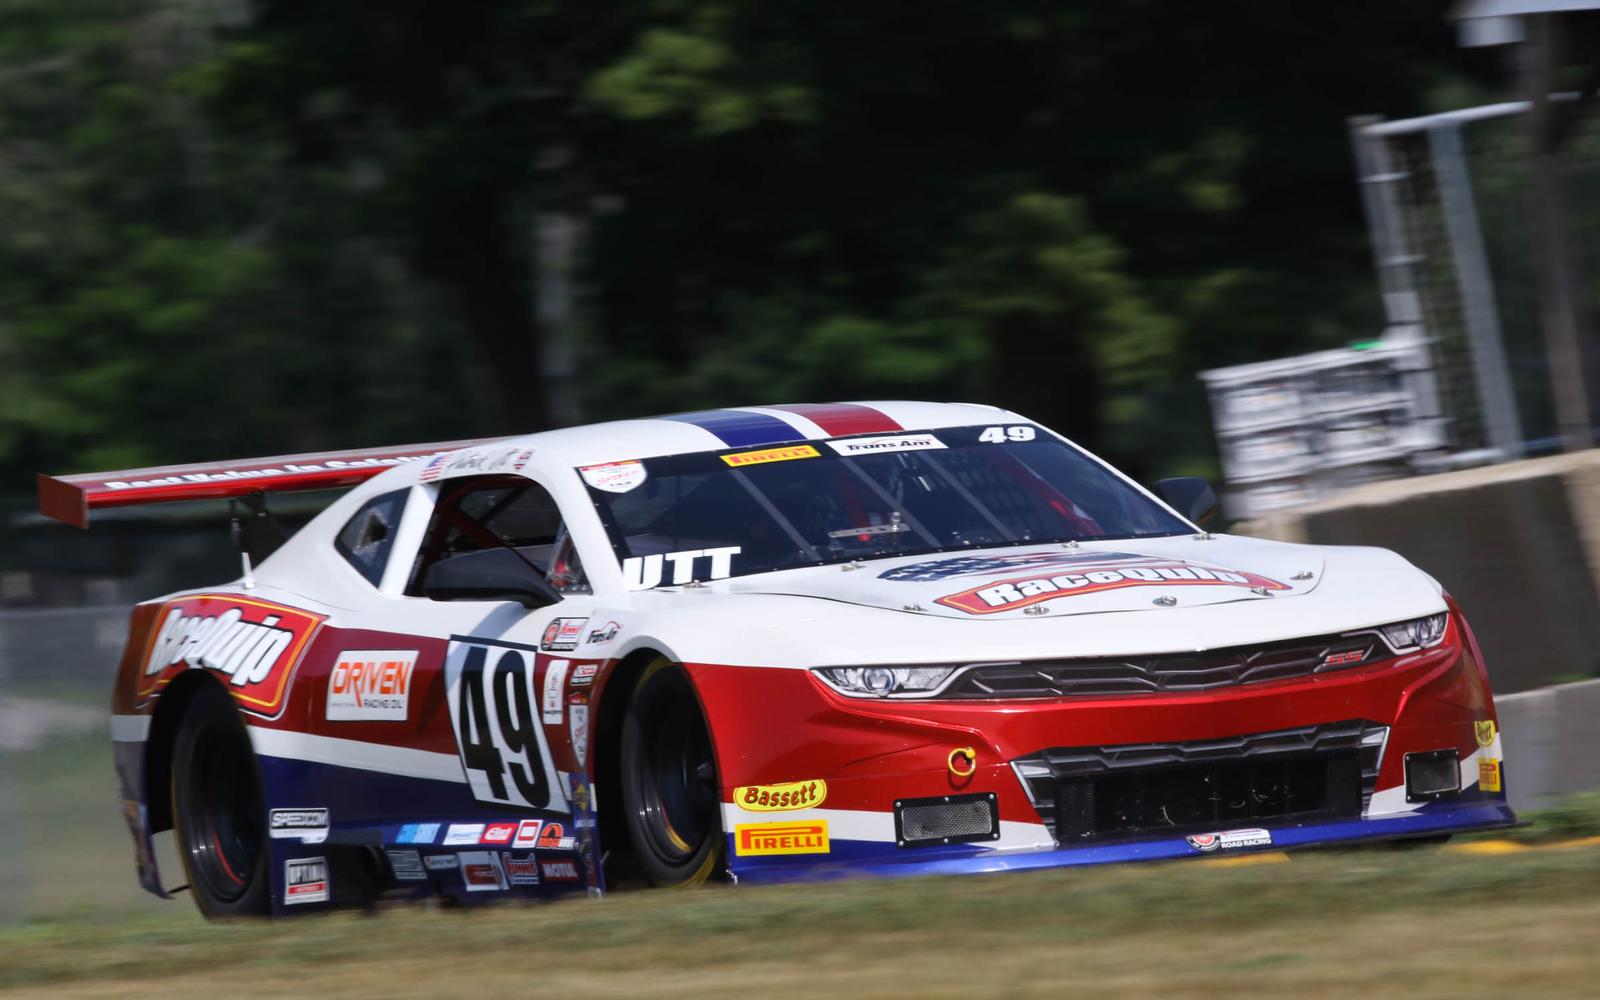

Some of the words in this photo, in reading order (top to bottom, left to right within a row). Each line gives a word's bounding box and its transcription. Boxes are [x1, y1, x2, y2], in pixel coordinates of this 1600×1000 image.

[979, 426, 1036, 443] 49
[847, 443, 896, 451] Trans
[623, 546, 741, 592] UTT
[332, 661, 410, 708] DRIVEN
[459, 646, 550, 809] 49
[744, 782, 817, 807] Bassett
[741, 826, 823, 850] PIRELLI
[1221, 840, 1243, 849] ROAD
[1243, 838, 1272, 847] RACING
